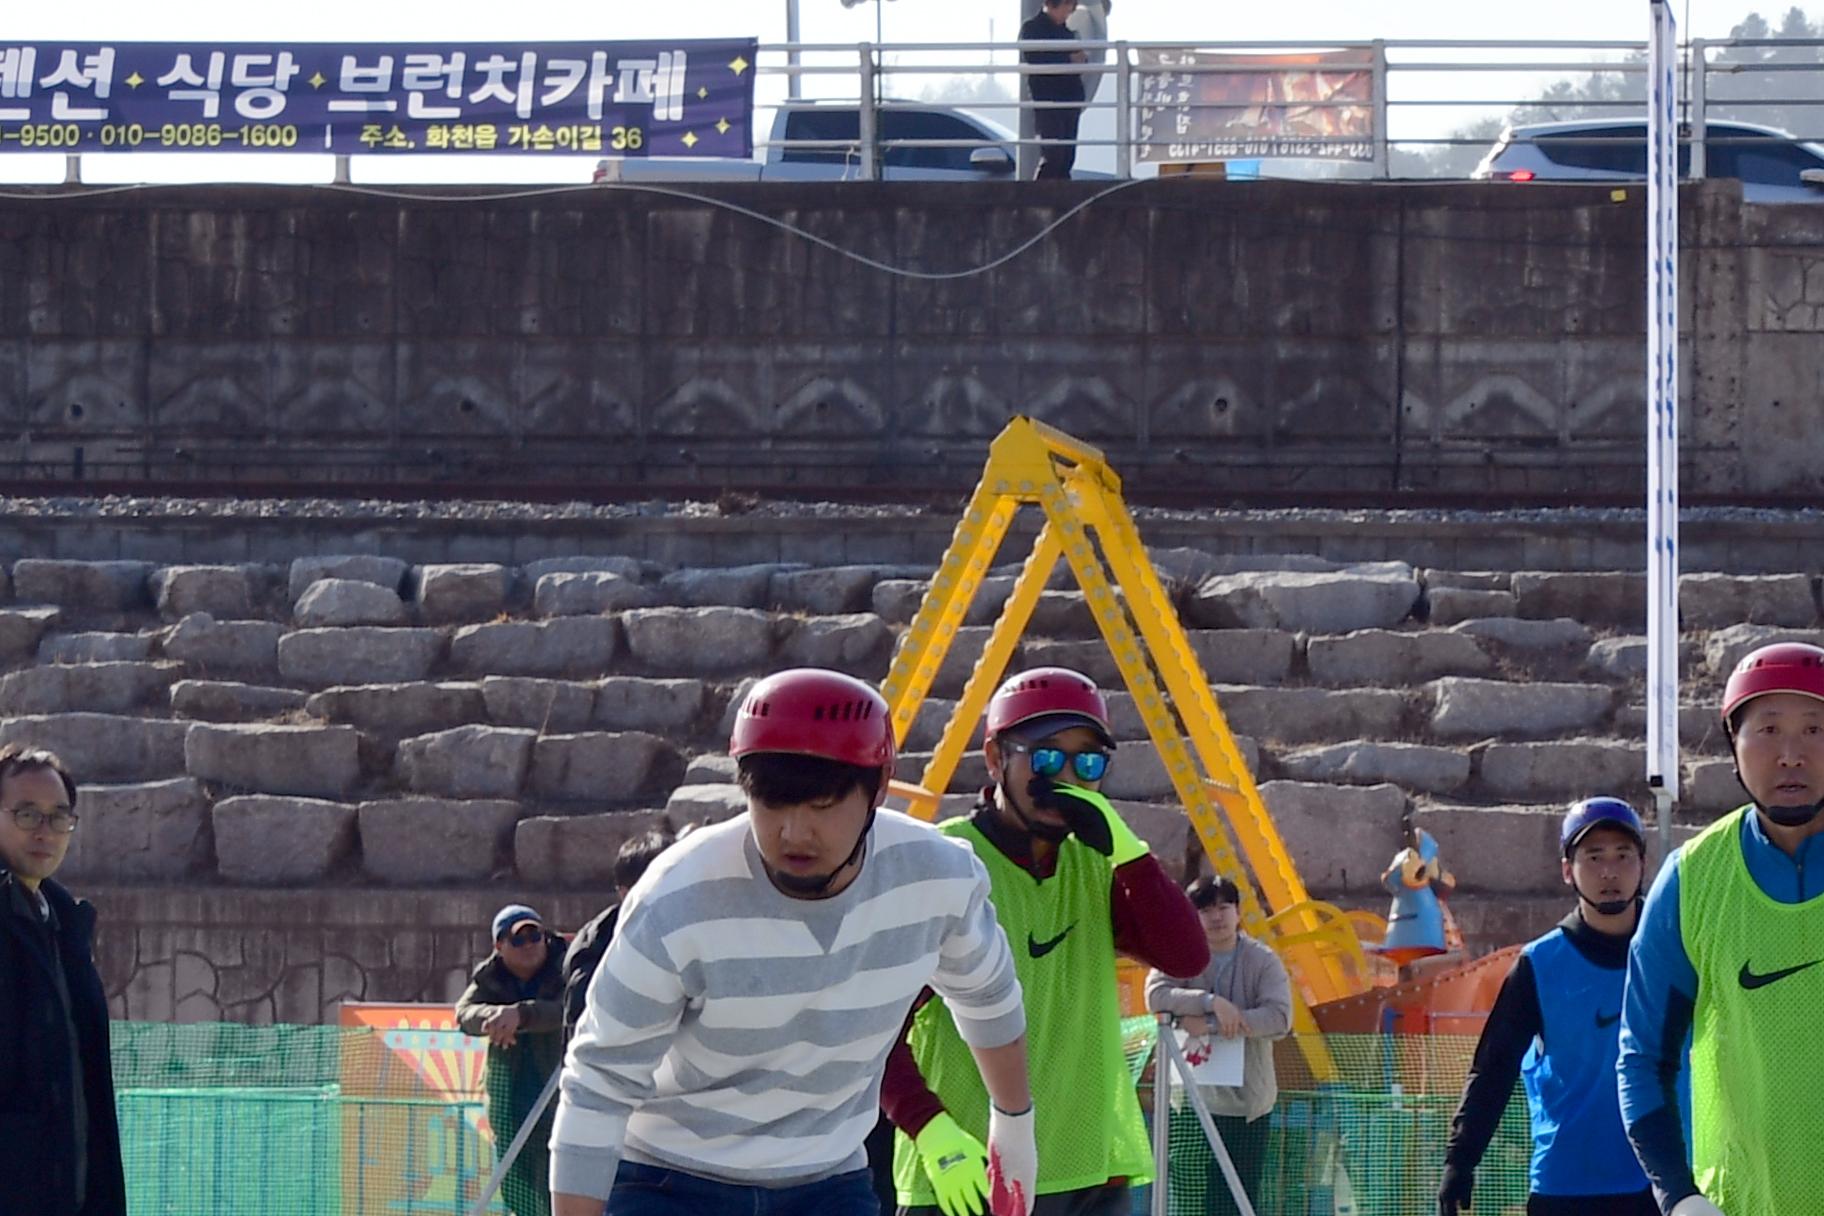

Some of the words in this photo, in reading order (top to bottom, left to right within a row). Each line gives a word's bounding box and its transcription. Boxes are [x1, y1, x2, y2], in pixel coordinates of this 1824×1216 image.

[156, 51, 300, 119] 식당
[327, 50, 687, 121] 브런치카페
[101, 123, 298, 148] 010-9086-1600
[425, 123, 498, 149] 화천읍
[611, 126, 643, 149] 36
